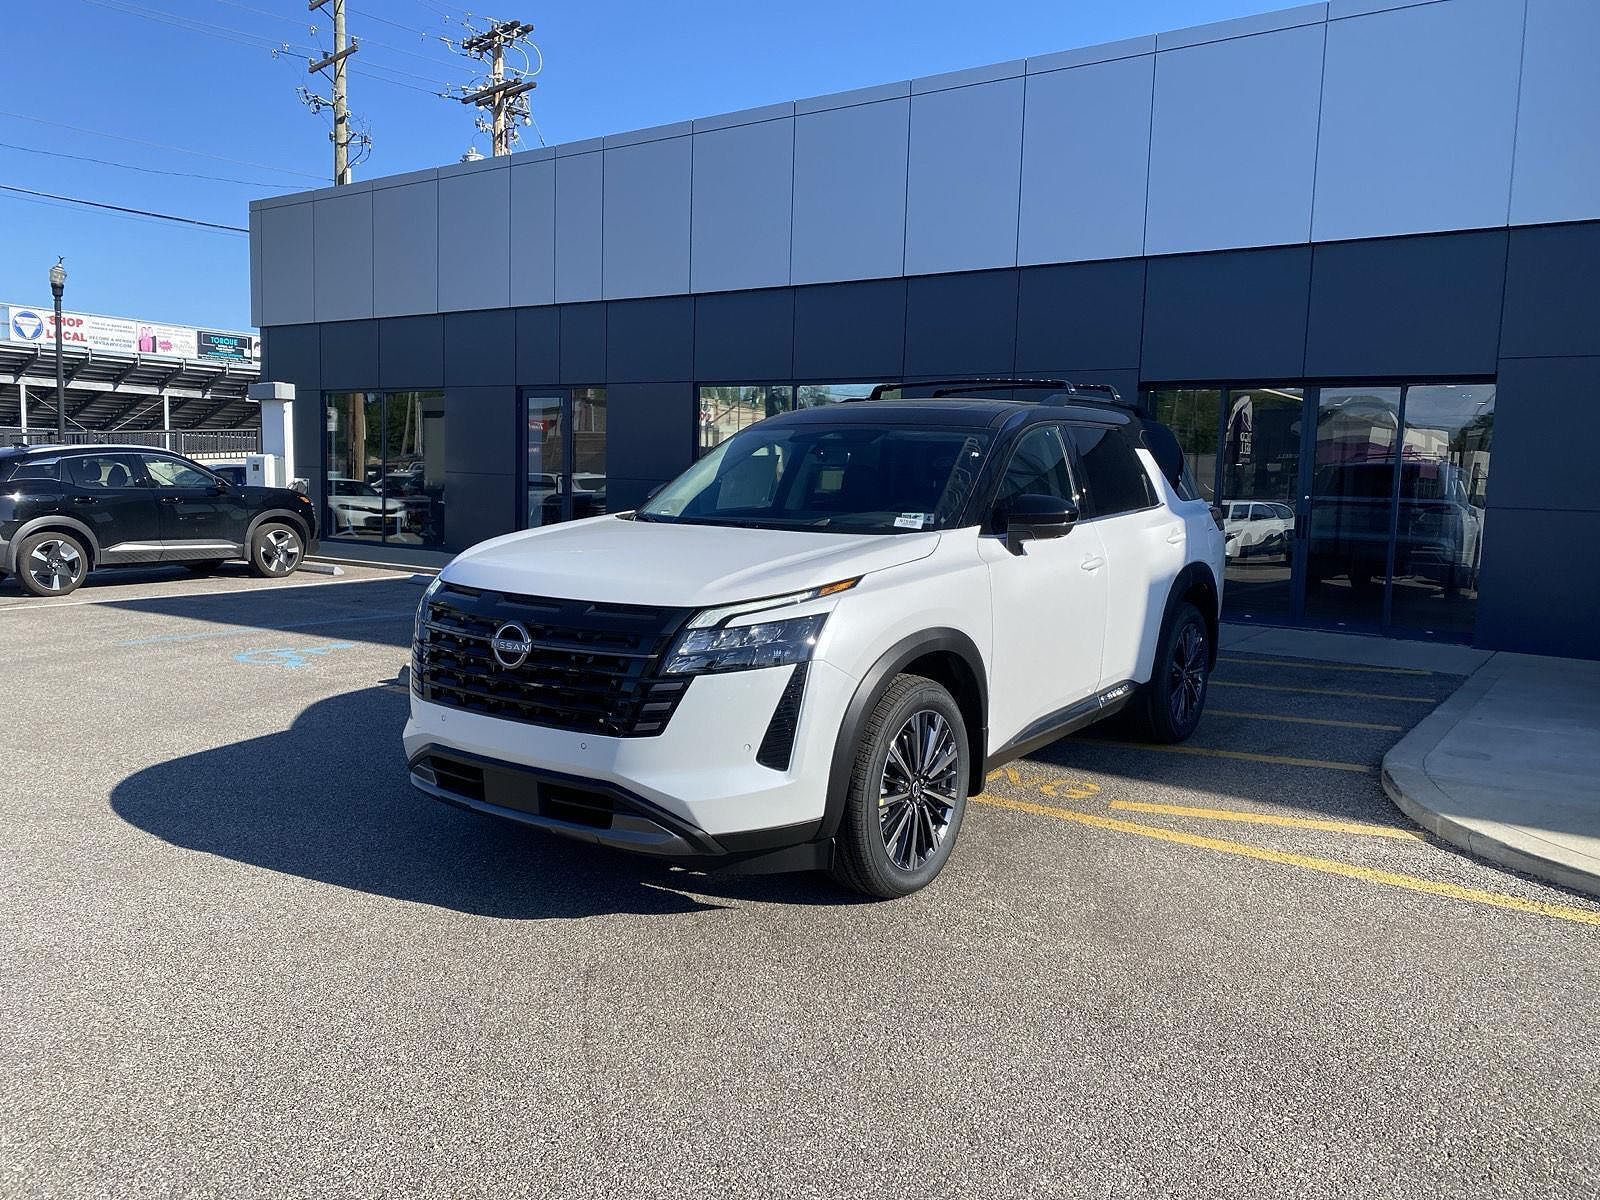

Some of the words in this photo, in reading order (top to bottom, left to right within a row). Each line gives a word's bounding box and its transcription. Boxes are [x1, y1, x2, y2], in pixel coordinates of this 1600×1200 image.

[46, 315, 84, 328] SHOP
[46, 329, 88, 342] LCAL
[210, 336, 238, 345] TORQUE
